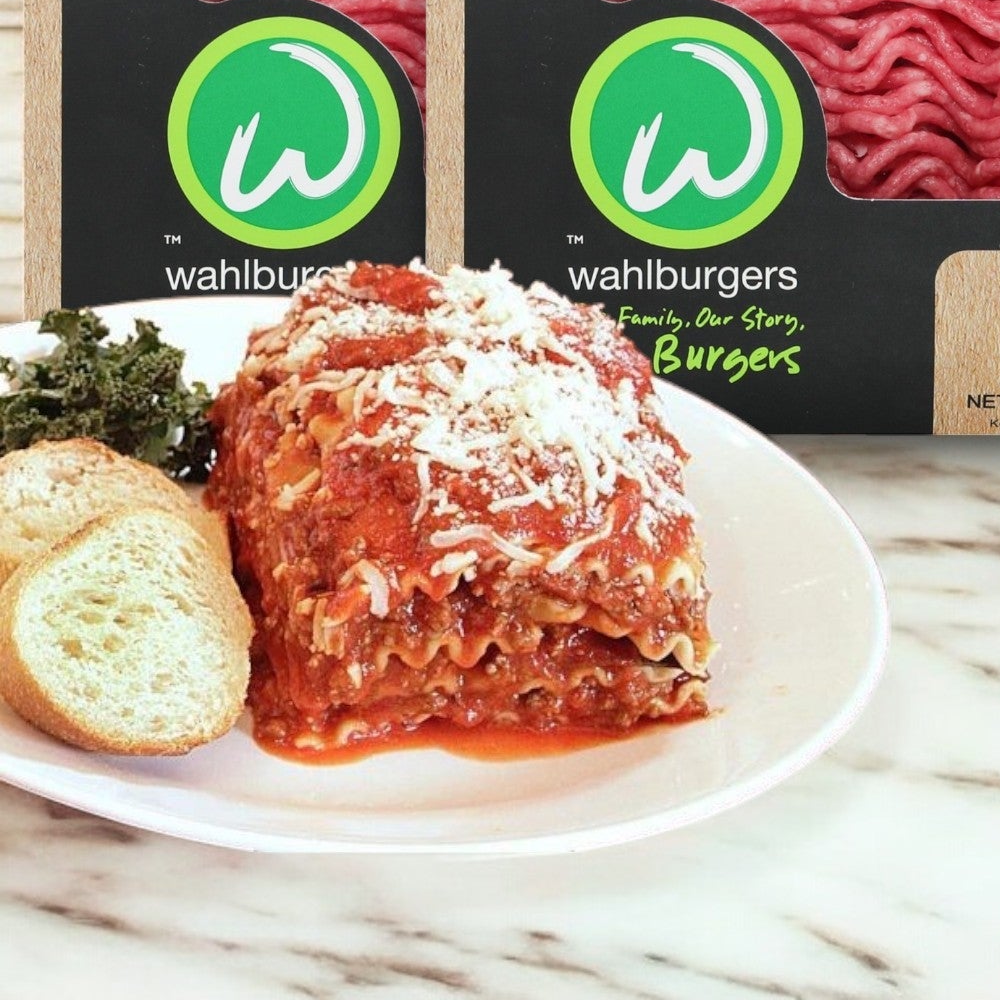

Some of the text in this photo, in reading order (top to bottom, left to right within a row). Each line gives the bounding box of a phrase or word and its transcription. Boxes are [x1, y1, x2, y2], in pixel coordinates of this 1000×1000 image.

[166, 259, 327, 292] wahlbur
[568, 259, 798, 300] wahlburgers
[618, 305, 806, 336] Family, Our Story,
[654, 332, 800, 382] Burgers
